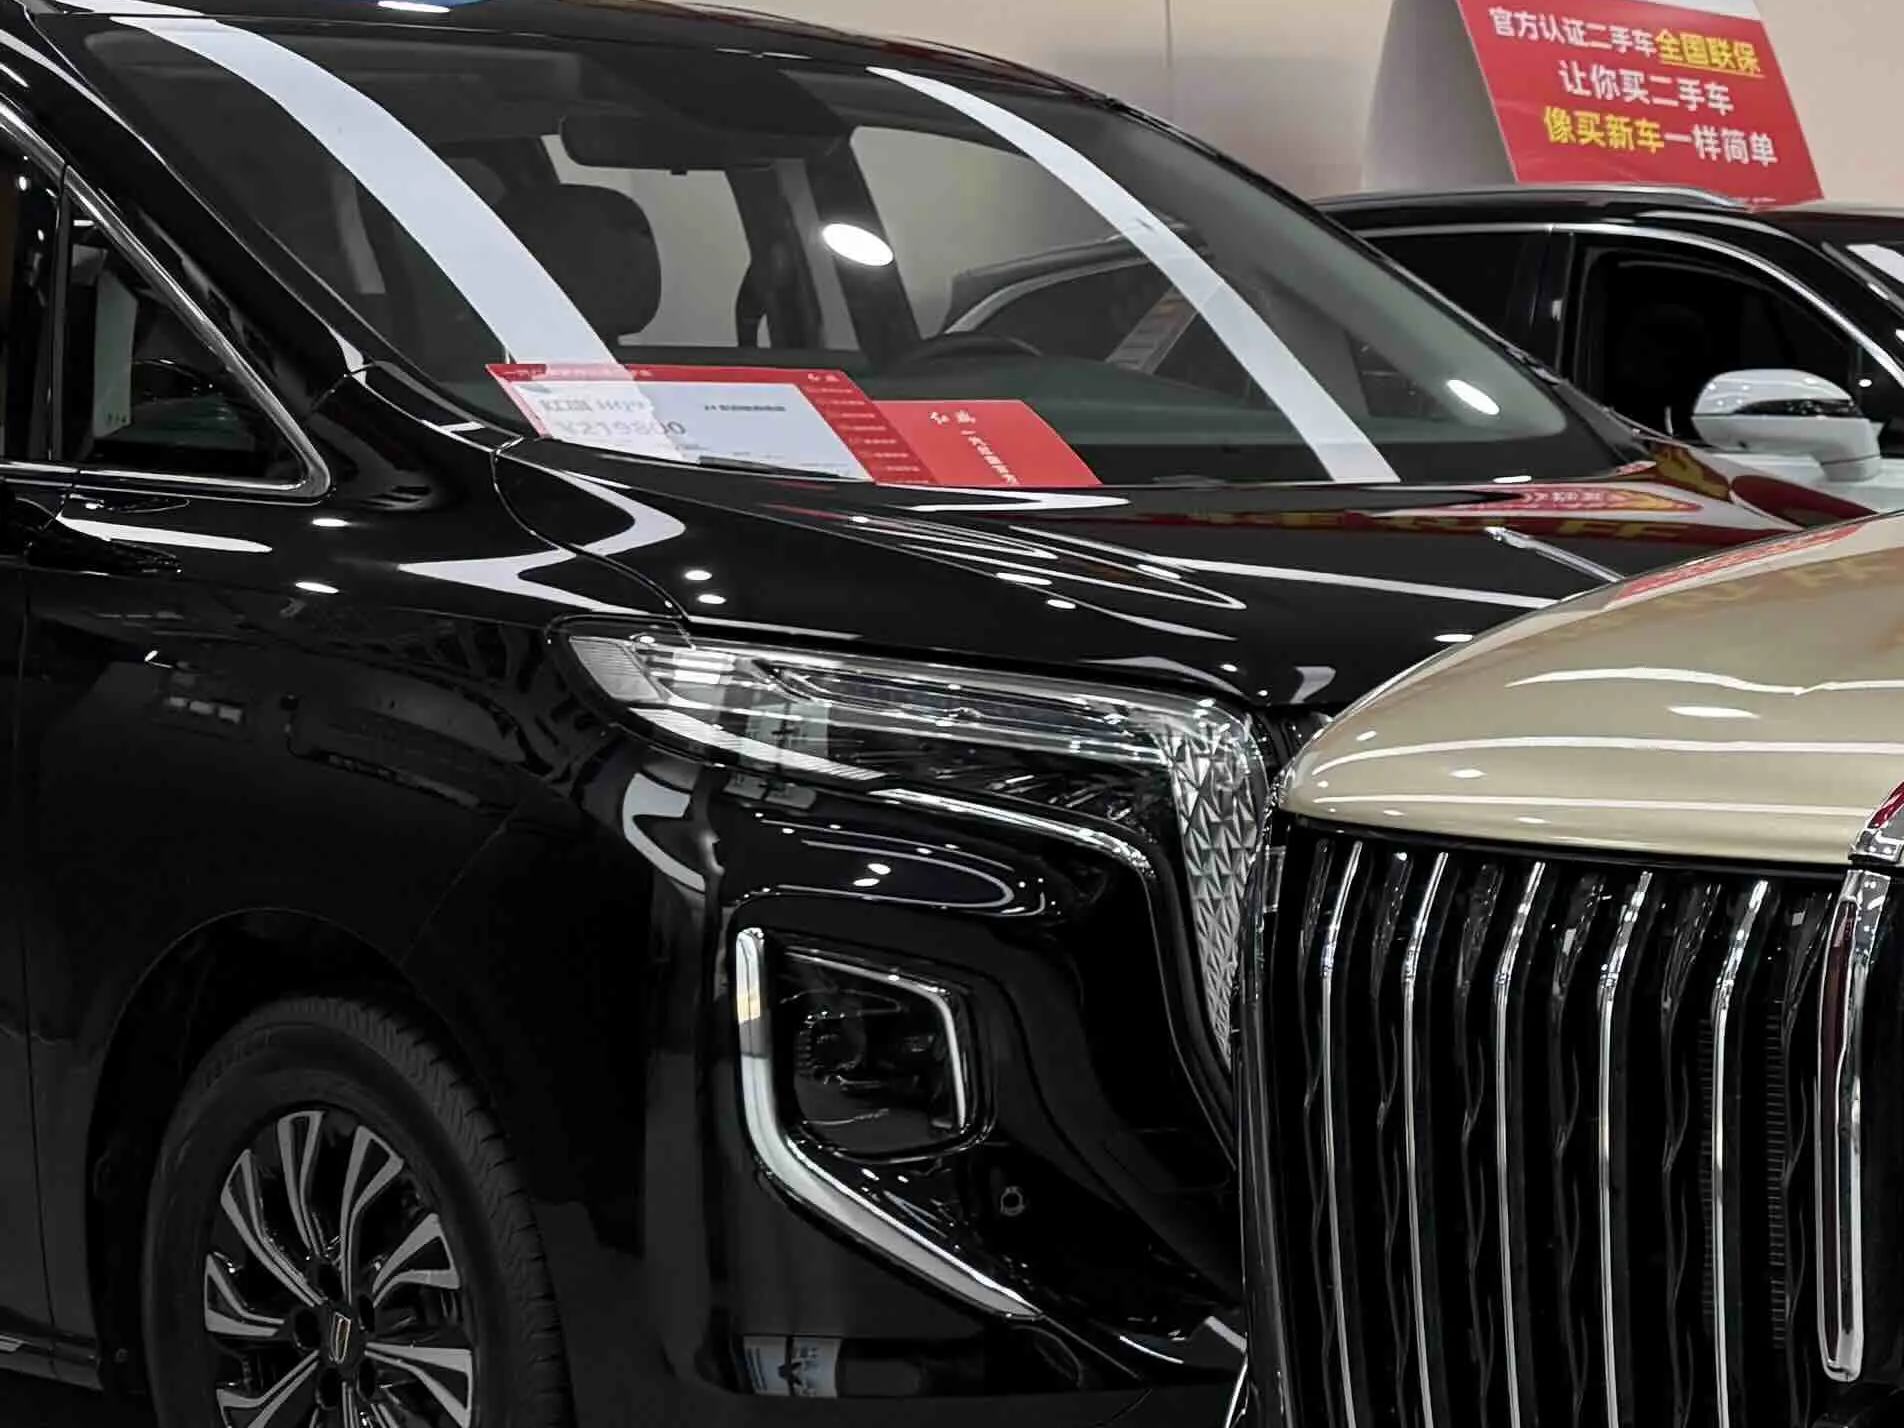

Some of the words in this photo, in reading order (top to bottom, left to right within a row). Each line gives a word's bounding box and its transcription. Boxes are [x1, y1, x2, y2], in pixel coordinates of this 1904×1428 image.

[1488, 6, 1761, 73] 官方认证二手车全国联保
[1558, 61, 1735, 116] 让你买二手车
[1544, 106, 1779, 168] 像买新车一样简单
